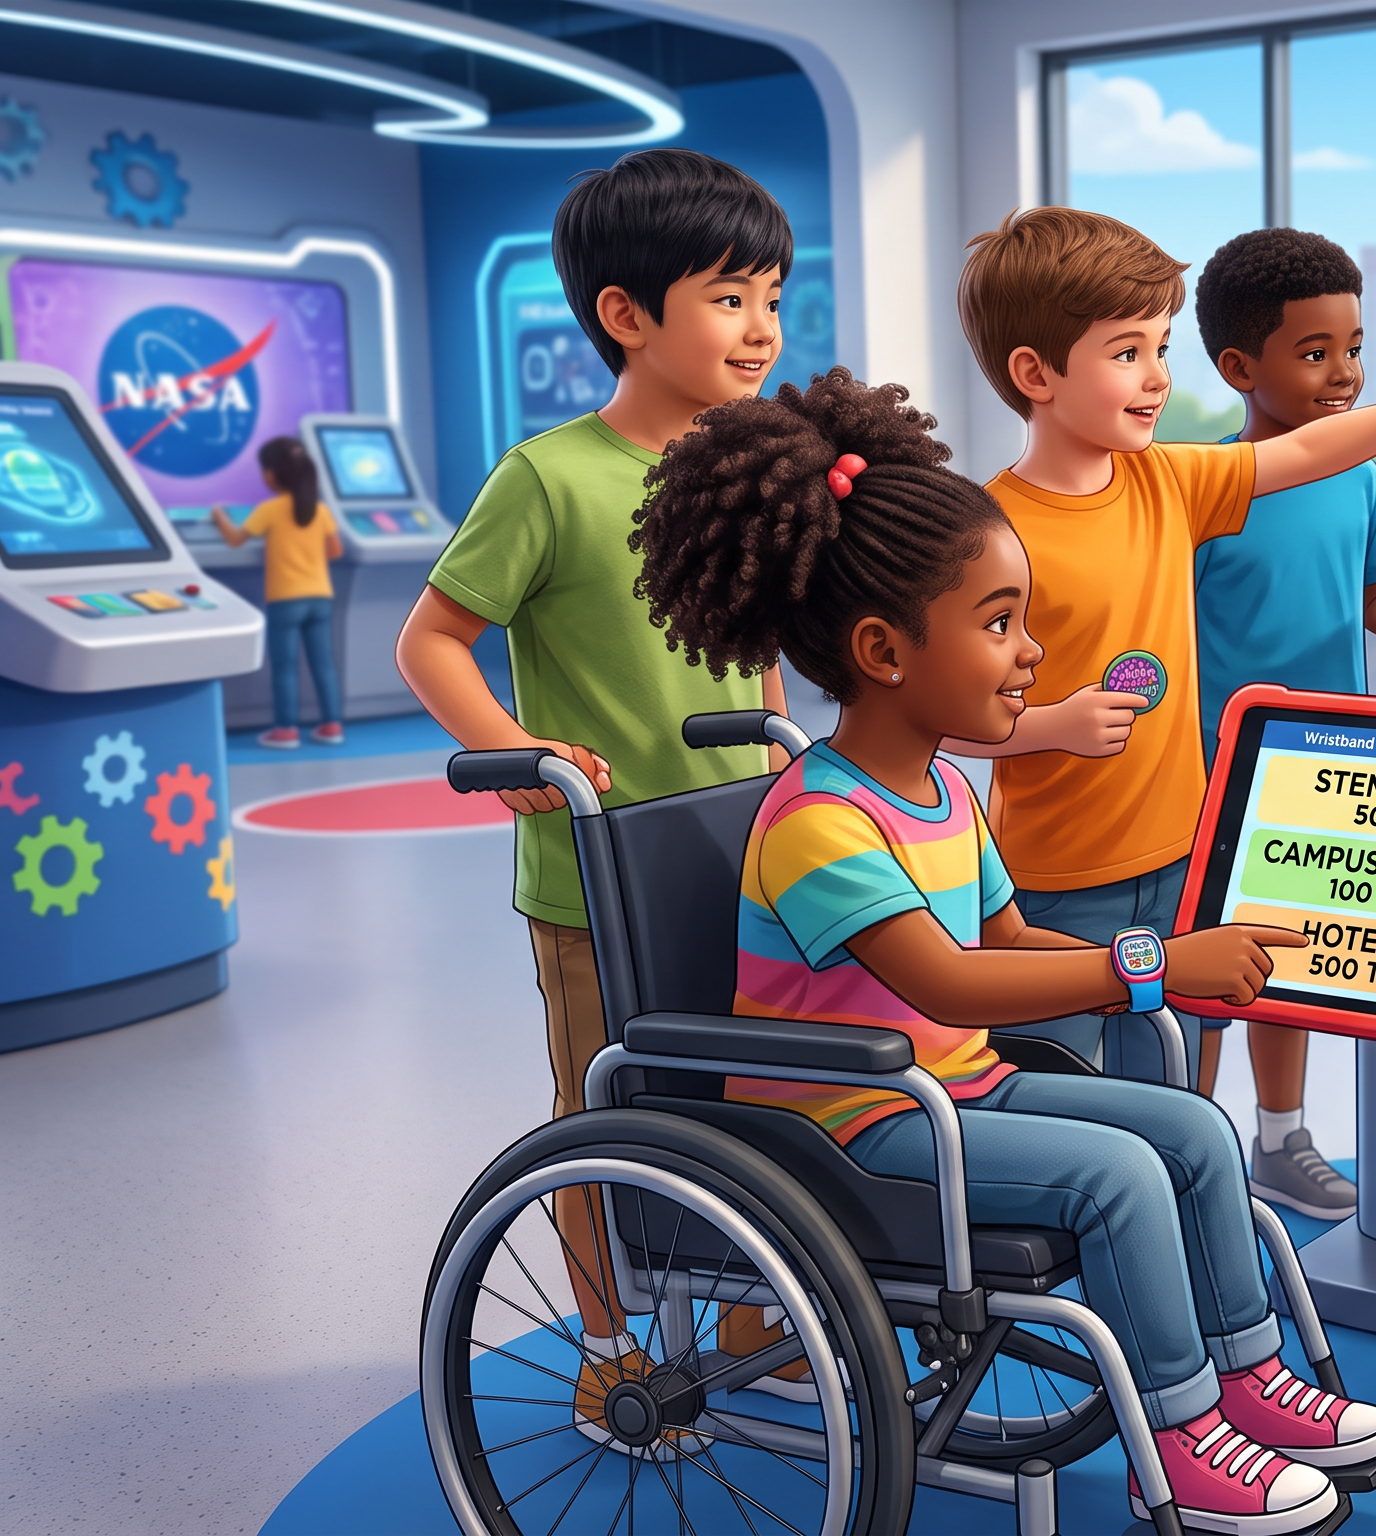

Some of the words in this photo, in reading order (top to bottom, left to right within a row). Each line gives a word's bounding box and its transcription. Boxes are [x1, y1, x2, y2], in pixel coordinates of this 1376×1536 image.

[111, 371, 251, 411] NASA
[1304, 730, 1375, 750] Wristband
[1330, 878, 1373, 903] 100
[1308, 953, 1359, 980] 500
